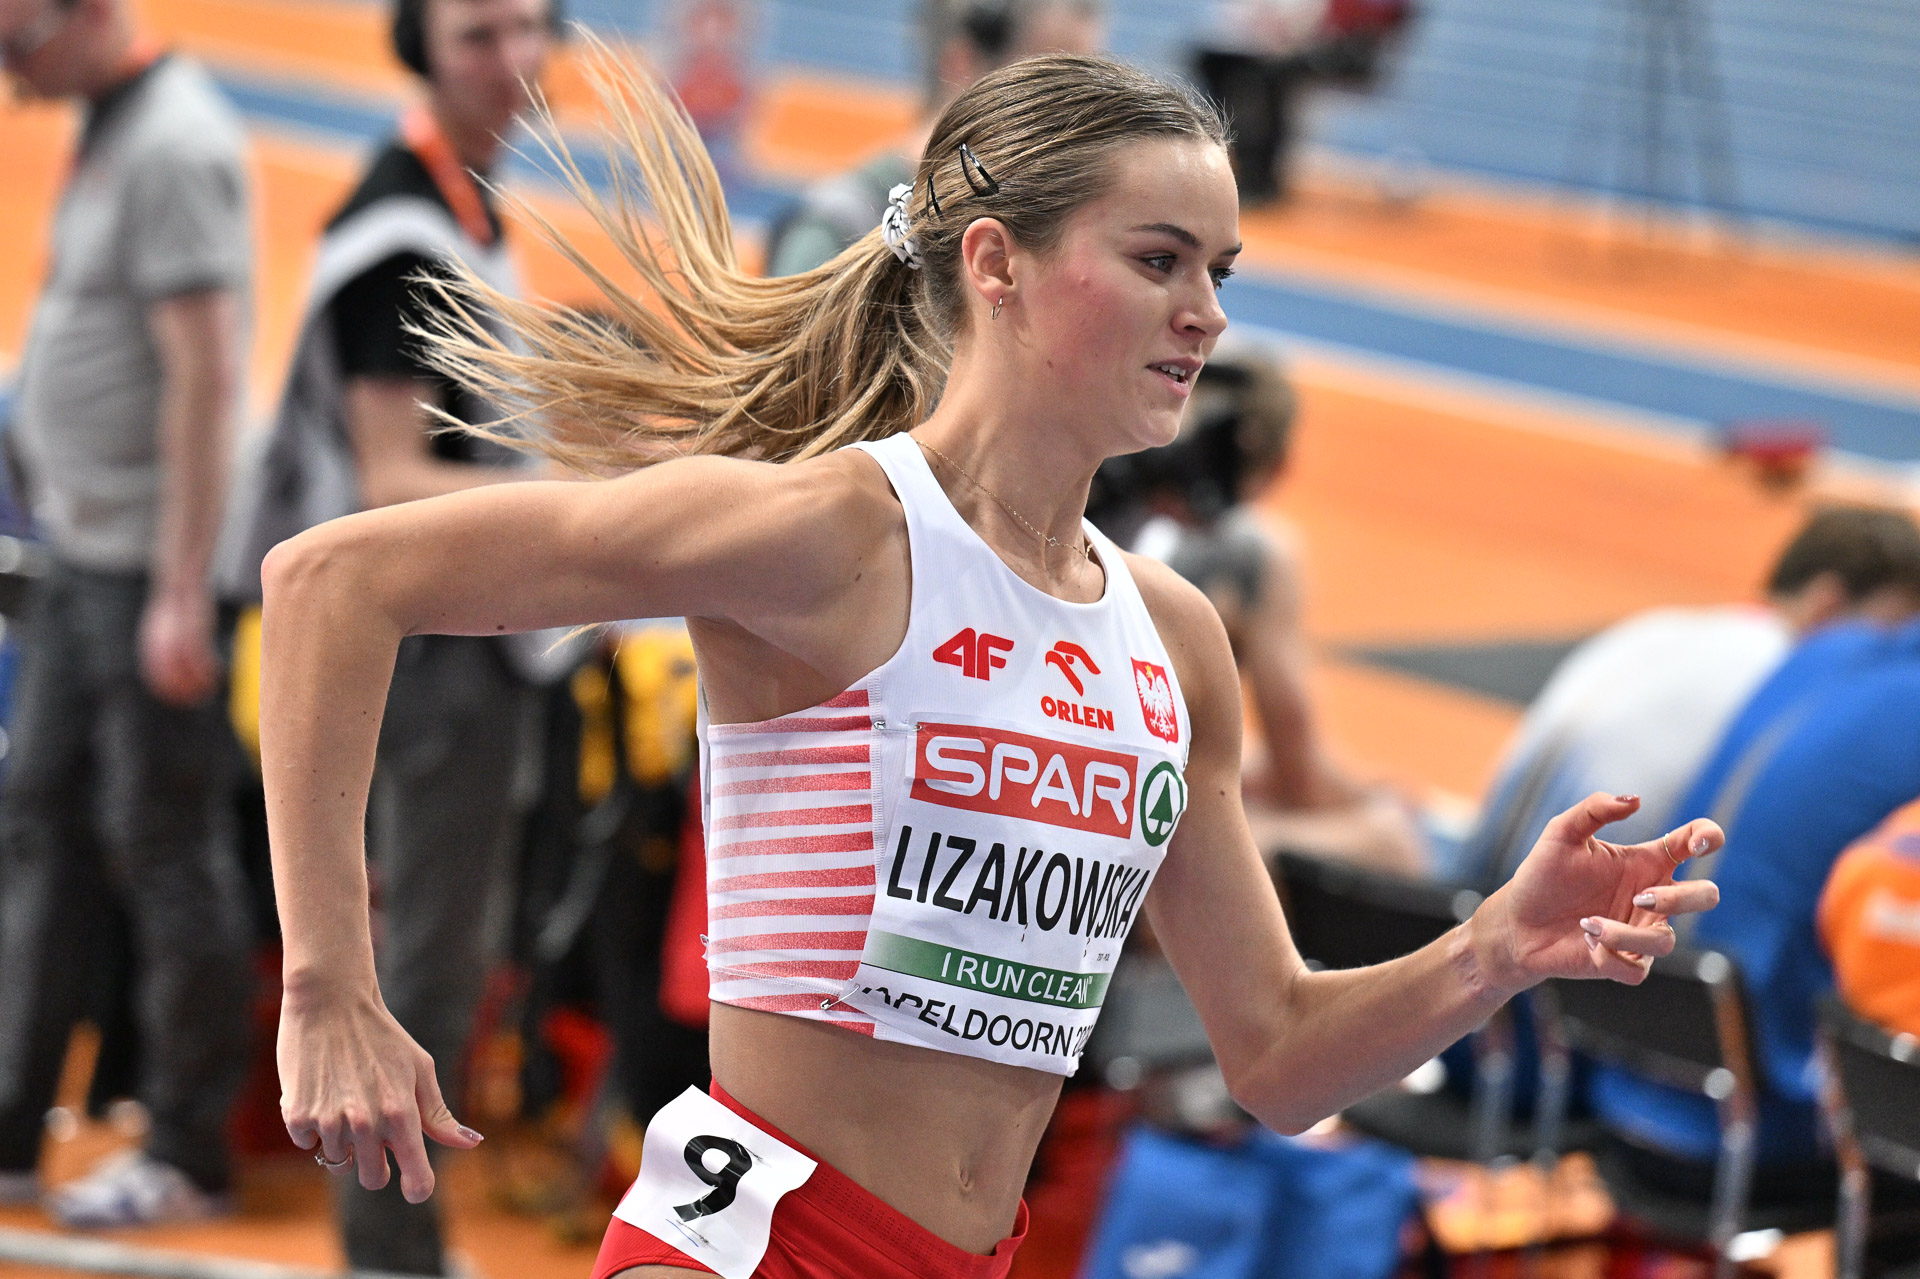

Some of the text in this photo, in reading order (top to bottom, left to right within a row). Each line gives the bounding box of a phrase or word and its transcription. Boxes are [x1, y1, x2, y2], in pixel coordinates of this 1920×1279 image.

[932, 627, 1014, 681] 4F
[1040, 695, 1114, 732] ORLEN
[925, 735, 1130, 825] SPAR
[886, 825, 1150, 939] LIZAKOWSKA
[941, 952, 952, 978] I
[956, 955, 1026, 994] RUN
[673, 1134, 753, 1223] 9
